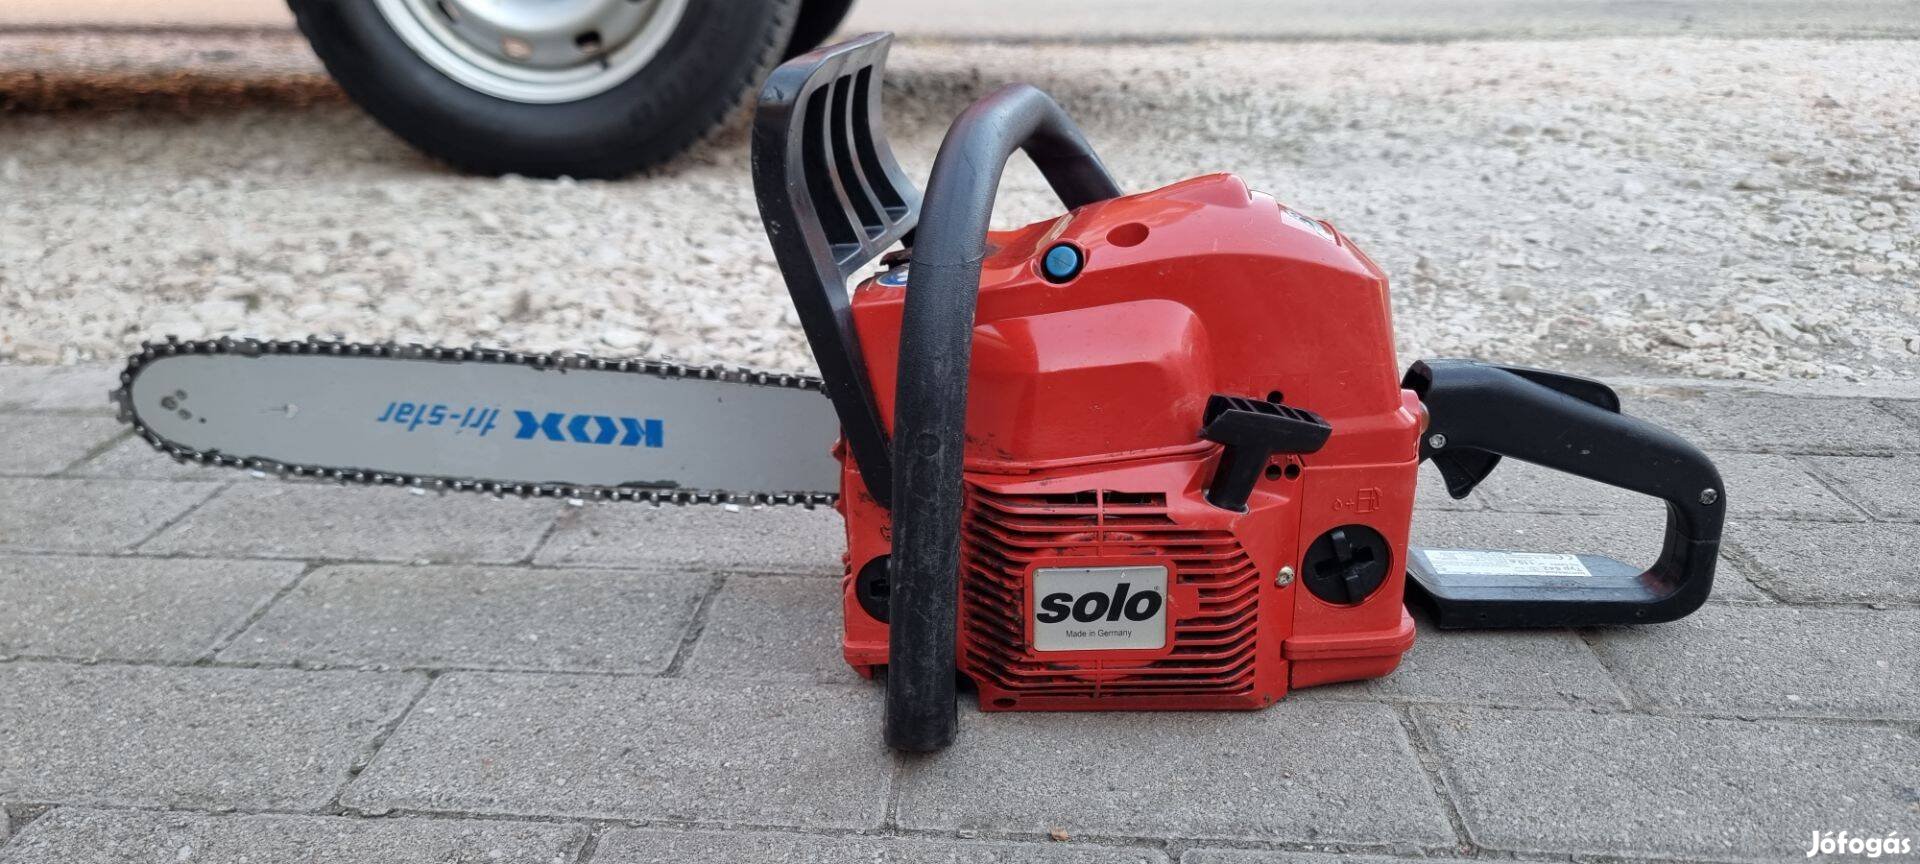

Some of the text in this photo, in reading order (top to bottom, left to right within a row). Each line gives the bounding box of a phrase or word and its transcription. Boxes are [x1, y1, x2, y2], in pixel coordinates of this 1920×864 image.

[377, 402, 664, 448] KOX tri-star
[1036, 583, 1163, 624] solo
[1066, 629, 1132, 638] Made in Germany
